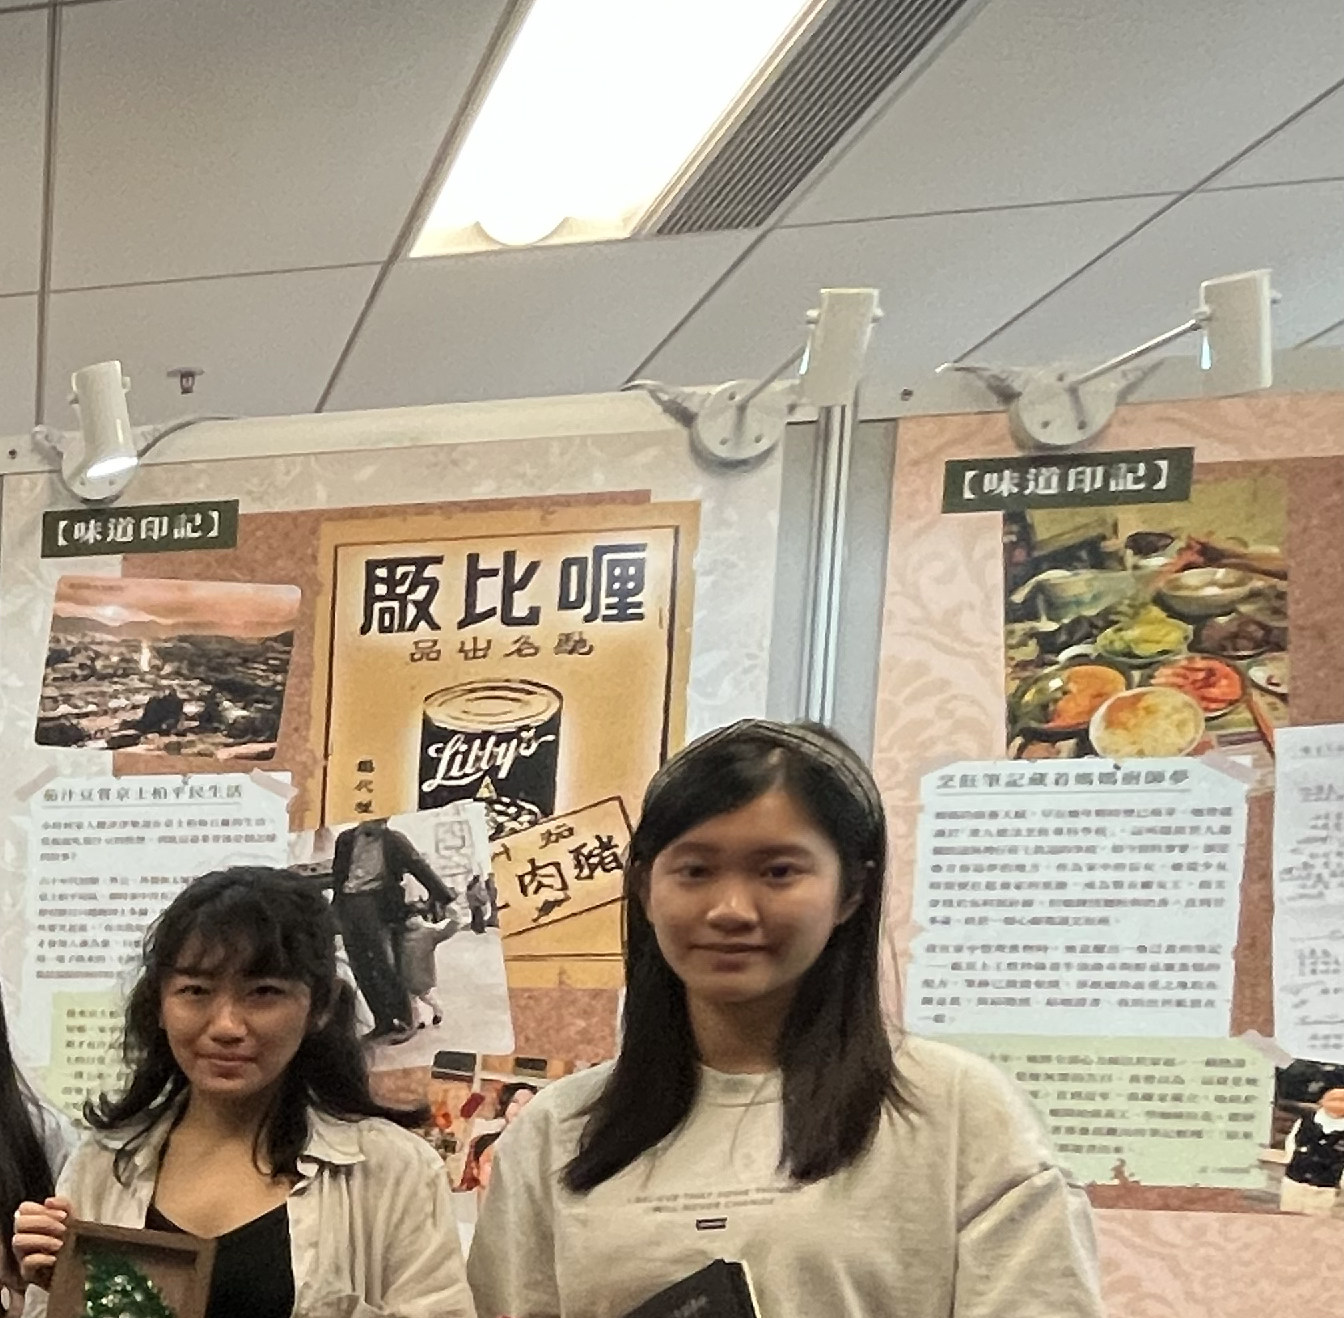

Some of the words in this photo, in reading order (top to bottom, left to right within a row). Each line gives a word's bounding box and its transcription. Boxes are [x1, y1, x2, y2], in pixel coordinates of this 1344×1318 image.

[963, 460, 1169, 500] 【味道印記】
[57, 510, 220, 546] 【味道印記】
[421, 724, 556, 792] Libby's
